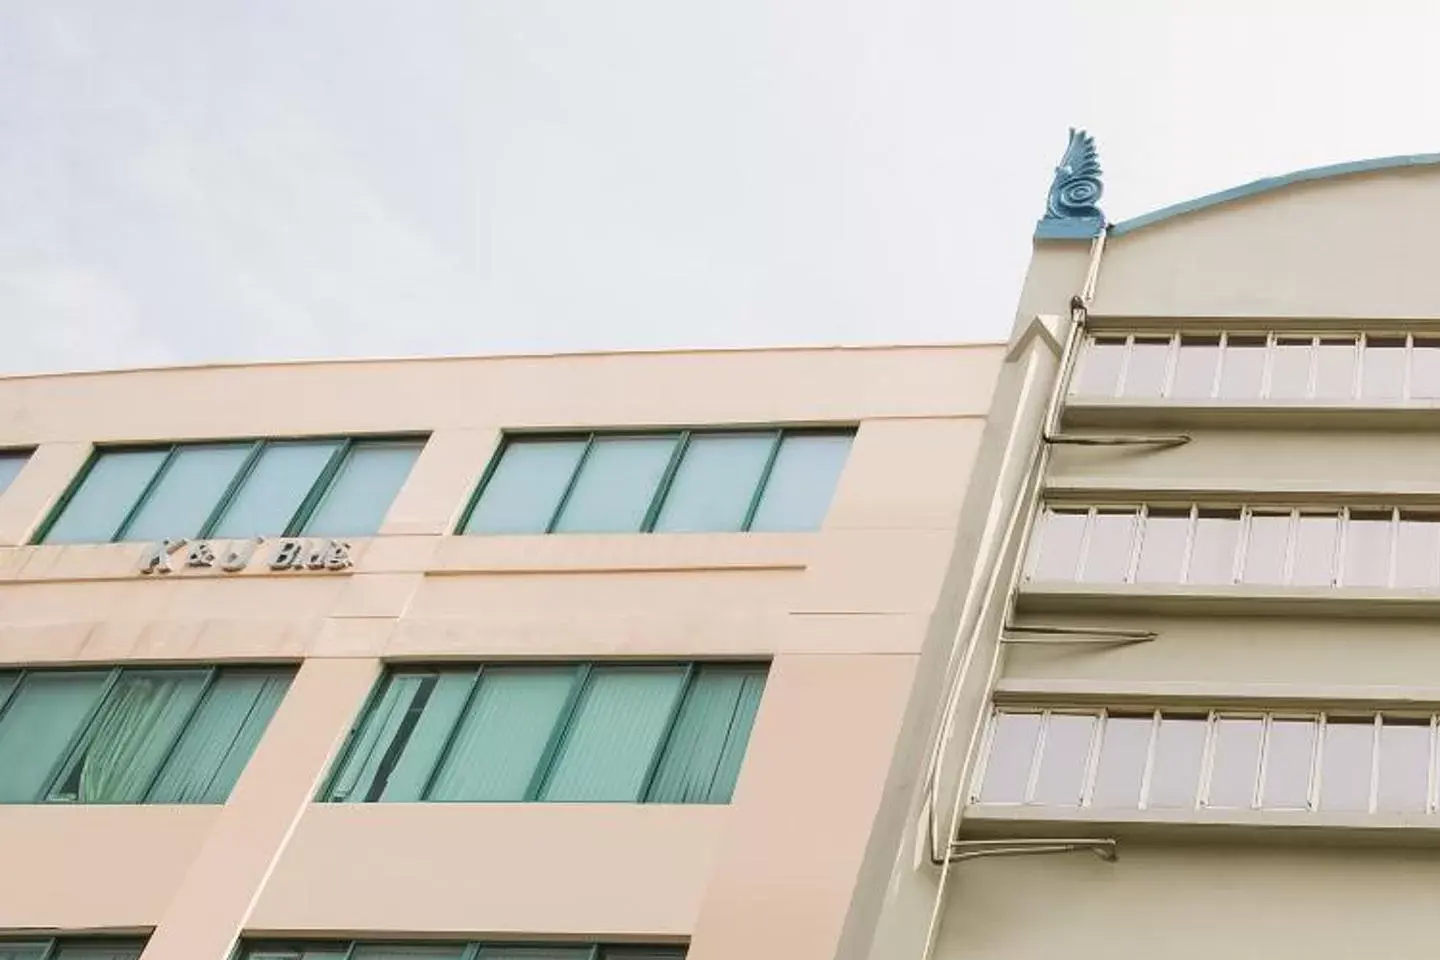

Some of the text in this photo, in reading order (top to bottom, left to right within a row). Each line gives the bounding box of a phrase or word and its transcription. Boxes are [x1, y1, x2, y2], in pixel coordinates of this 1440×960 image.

[141, 538, 187, 574] K
[185, 540, 215, 567] &
[218, 538, 263, 572] J
